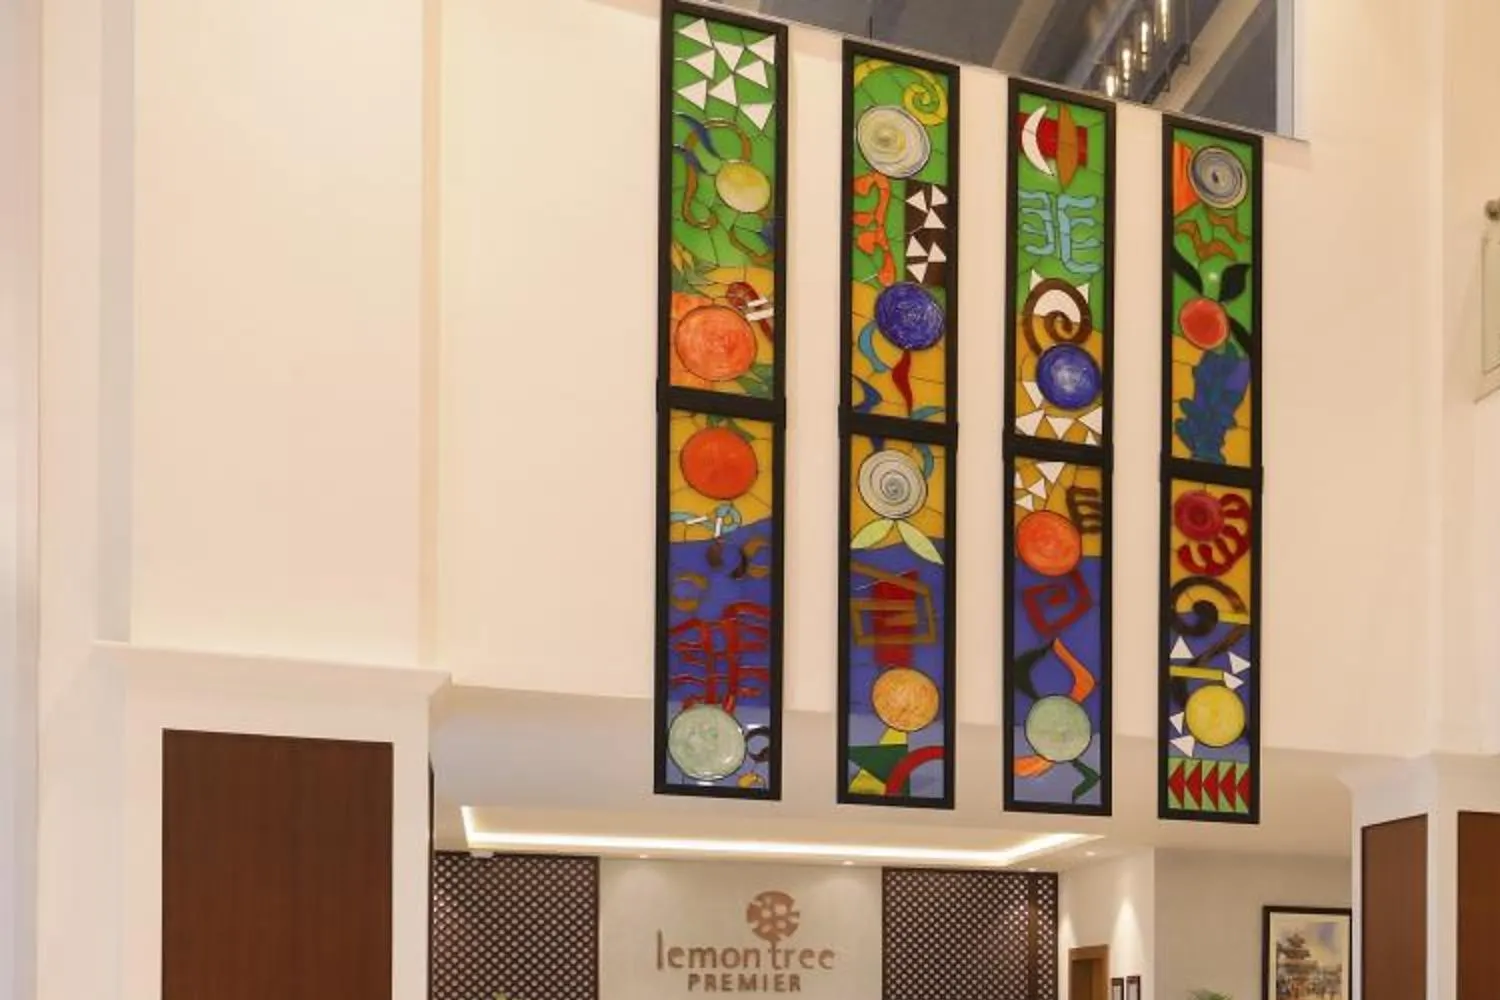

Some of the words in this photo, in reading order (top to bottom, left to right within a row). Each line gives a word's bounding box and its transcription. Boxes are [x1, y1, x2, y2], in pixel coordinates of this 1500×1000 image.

[657, 929, 760, 970] lemon
[768, 939, 836, 970] tree
[687, 973, 802, 992] PREMIER
